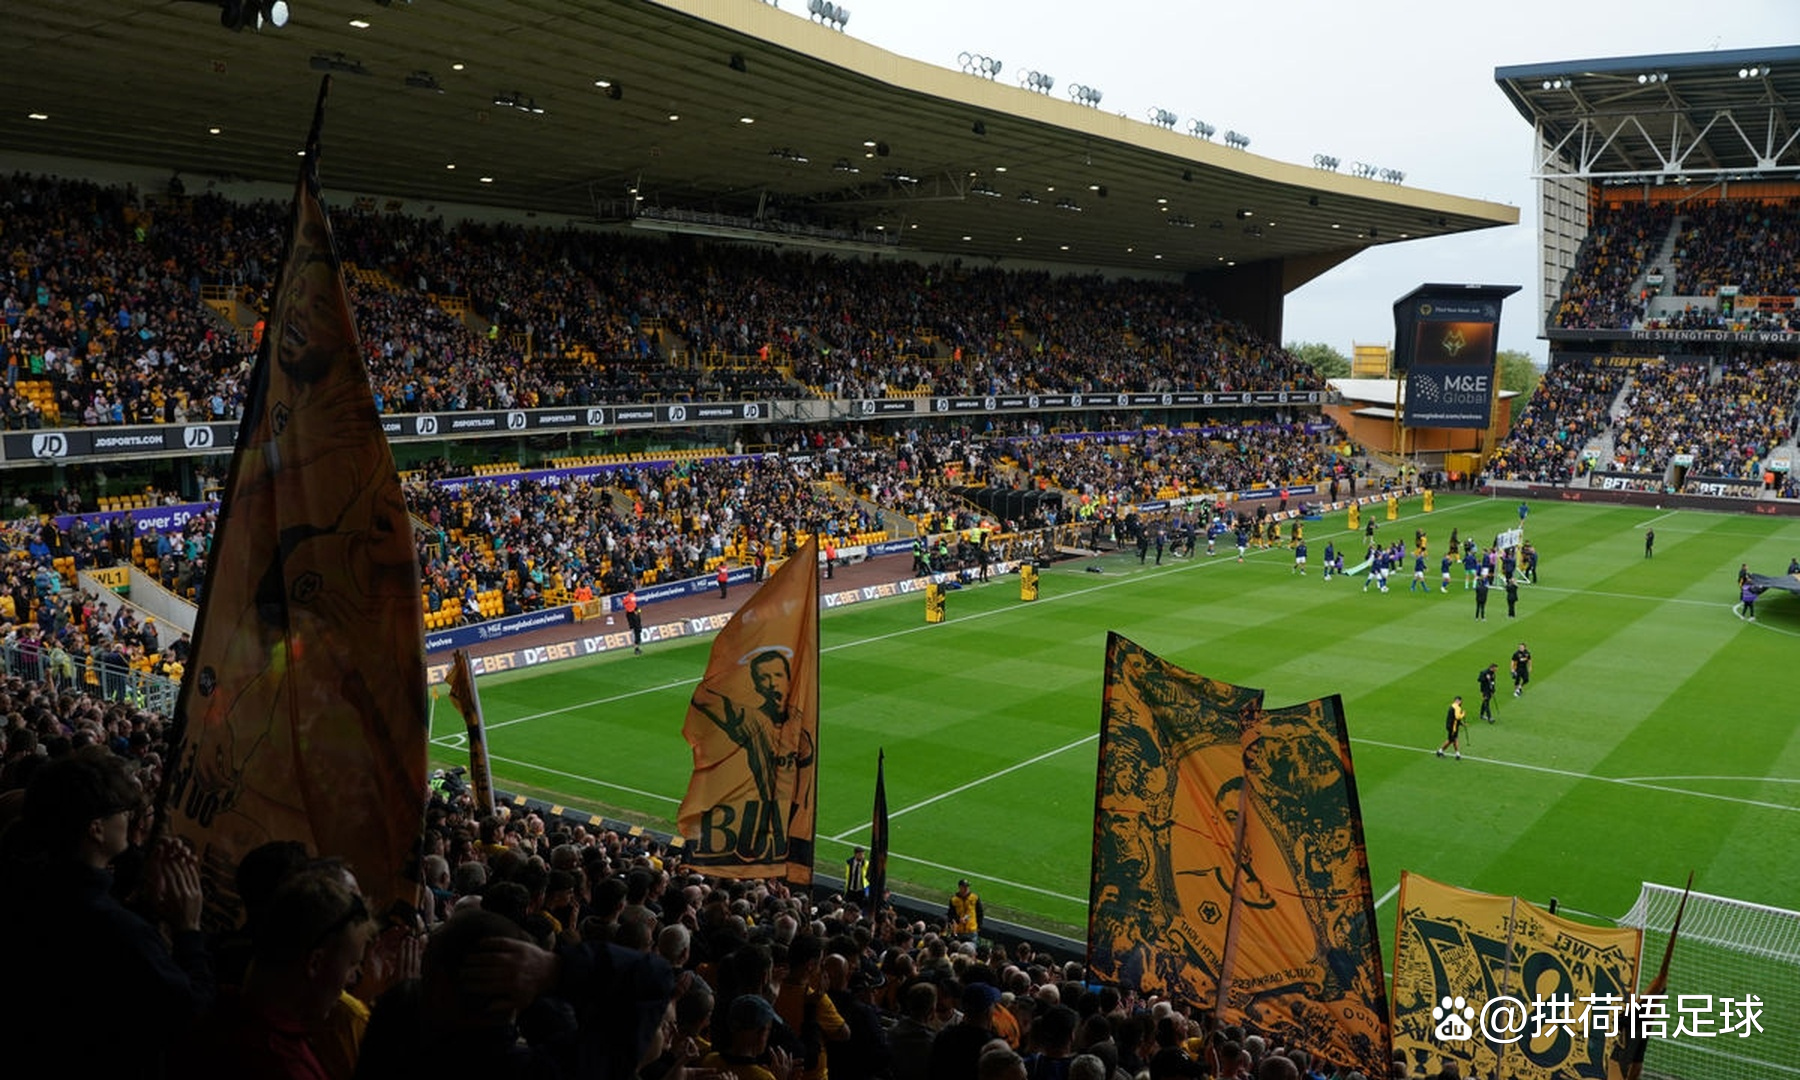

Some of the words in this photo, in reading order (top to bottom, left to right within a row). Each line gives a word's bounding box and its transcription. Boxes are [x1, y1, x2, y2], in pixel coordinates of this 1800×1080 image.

[1655, 332, 1711, 341] STRENGTH
[1734, 333, 1753, 341] THE
[1760, 333, 1792, 342] WOLF
[1444, 375, 1488, 392] M&E
[1442, 392, 1487, 404] Global
[41, 435, 62, 455] JD
[95, 434, 163, 447] JDSPORTS.COM
[188, 427, 209, 446] JD
[138, 516, 171, 531] over
[173, 511, 191, 527] 50
[824, 588, 860, 607] DEBET
[641, 620, 685, 643] DEBET
[584, 630, 633, 654] DEBET
[524, 641, 576, 665] DEBET
